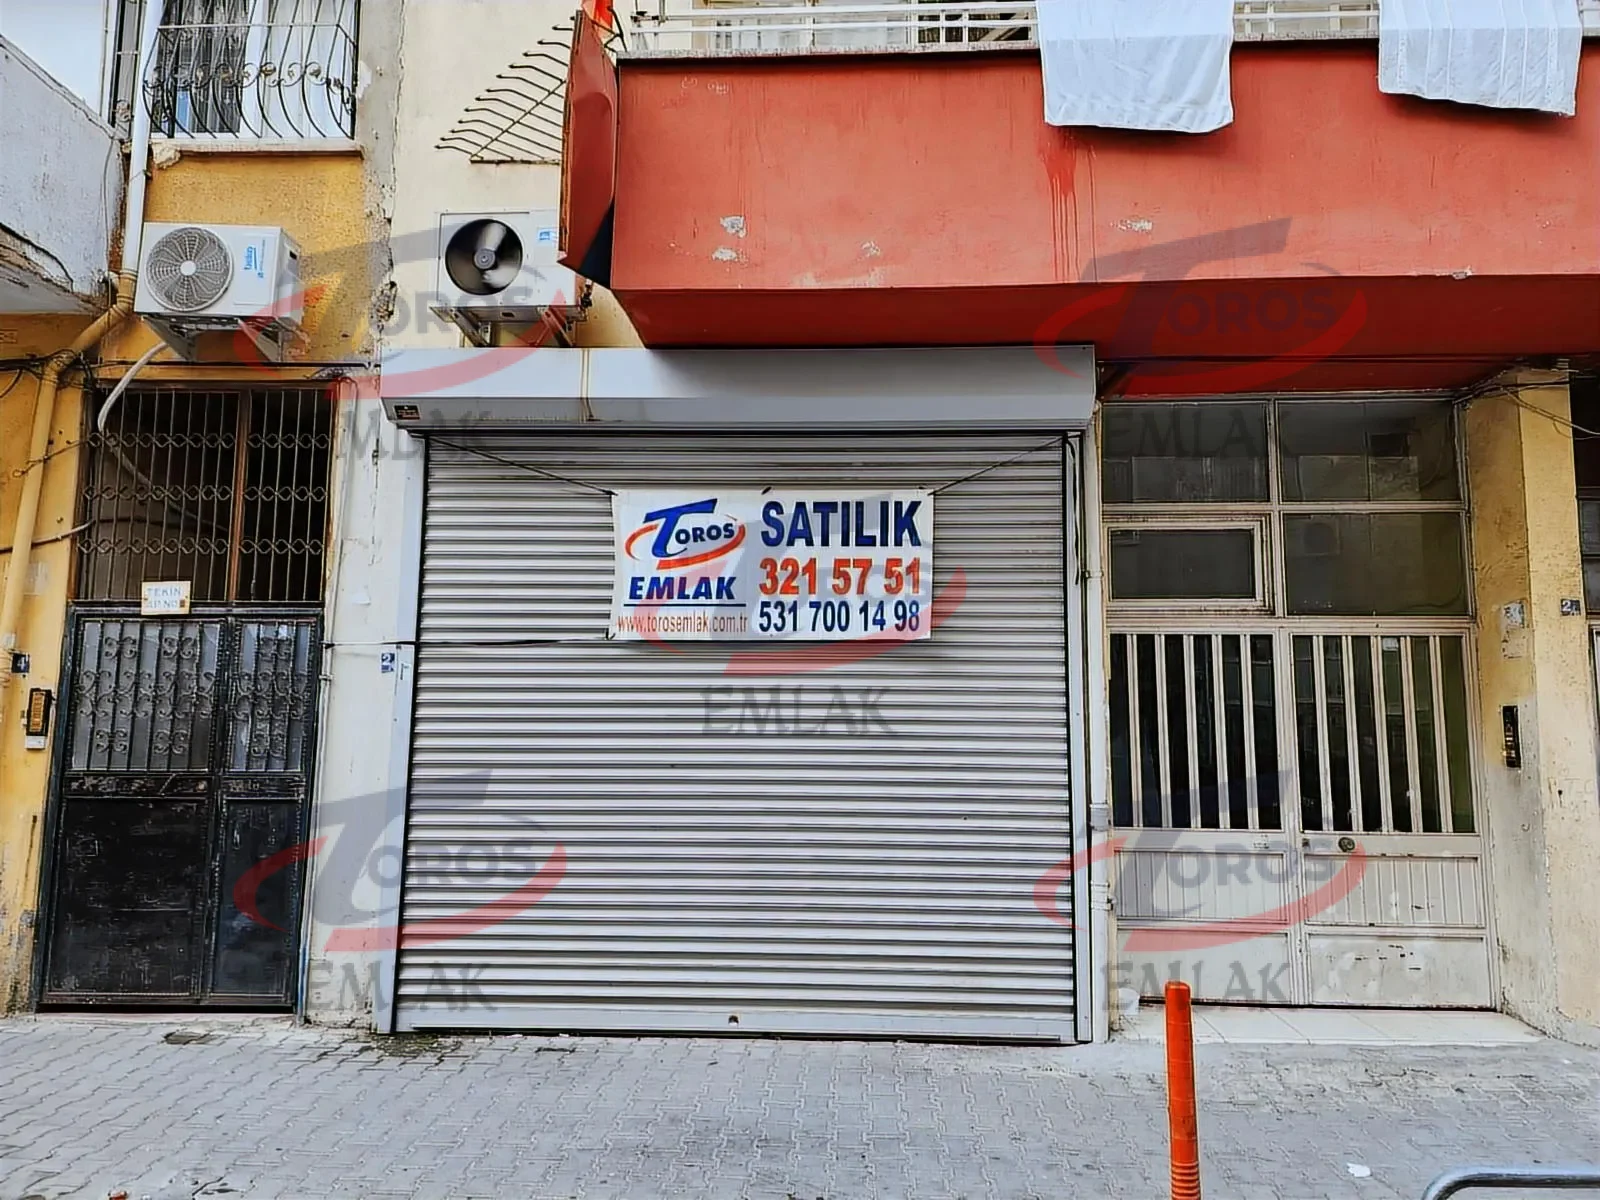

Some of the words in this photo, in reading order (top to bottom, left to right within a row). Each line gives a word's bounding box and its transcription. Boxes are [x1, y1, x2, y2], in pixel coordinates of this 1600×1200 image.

[643, 498, 735, 558] TOROS
[761, 500, 922, 547] SATILIK
[629, 576, 737, 600] EMLAK
[759, 557, 817, 595] 321
[831, 558, 873, 595] 57
[883, 557, 920, 595] 51
[617, 610, 748, 633] www.torosemlak.com.tr
[759, 600, 798, 632] 531
[809, 600, 850, 632] 700
[859, 600, 887, 632] 14
[894, 600, 920, 632] 98
